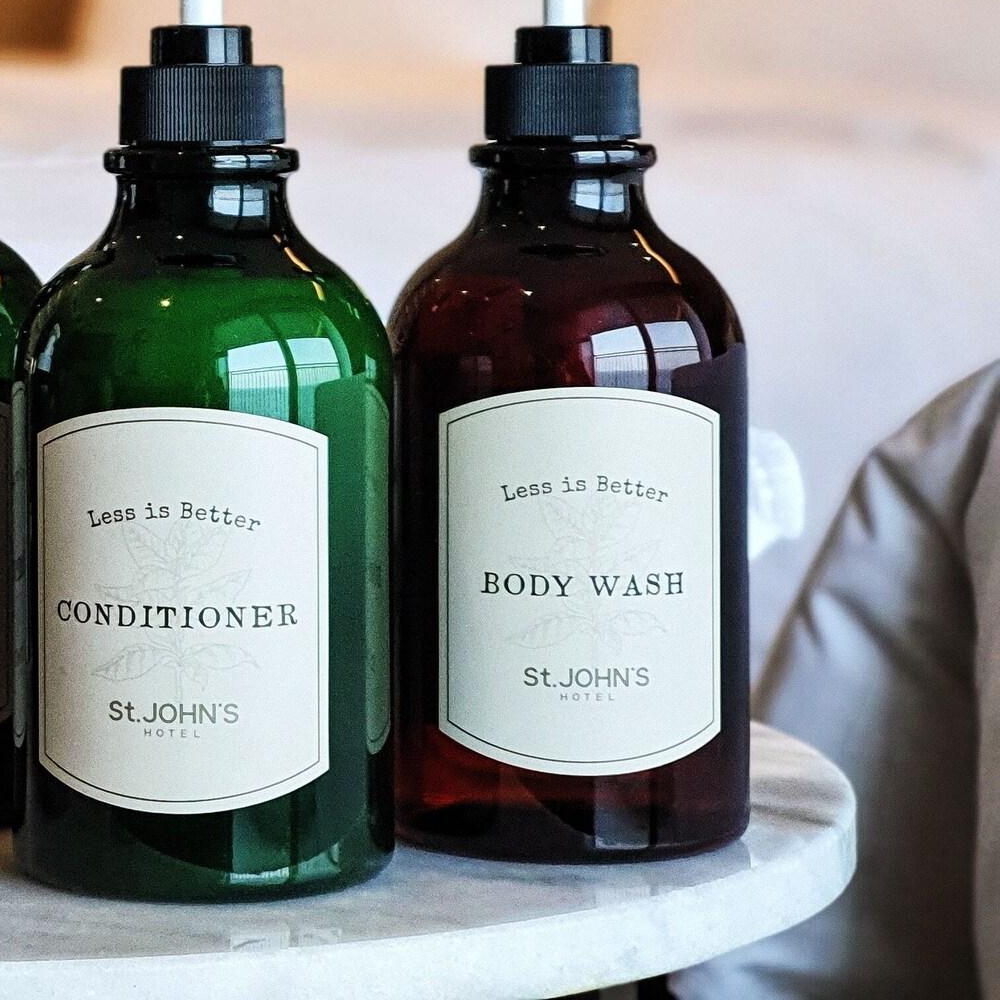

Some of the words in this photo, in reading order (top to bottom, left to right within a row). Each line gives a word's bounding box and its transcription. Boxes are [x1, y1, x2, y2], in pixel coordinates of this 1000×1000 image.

[500, 480, 553, 502] Less
[561, 476, 587, 494] is
[596, 475, 669, 504] Better
[88, 506, 137, 528] Less
[145, 502, 170, 520] is
[180, 501, 262, 532] Better
[481, 571, 576, 598] BODY
[589, 571, 685, 597] WASH
[56, 599, 299, 629] CONDITIONER
[559, 692, 615, 702] HOTEL
[143, 727, 201, 738] HOTEL
